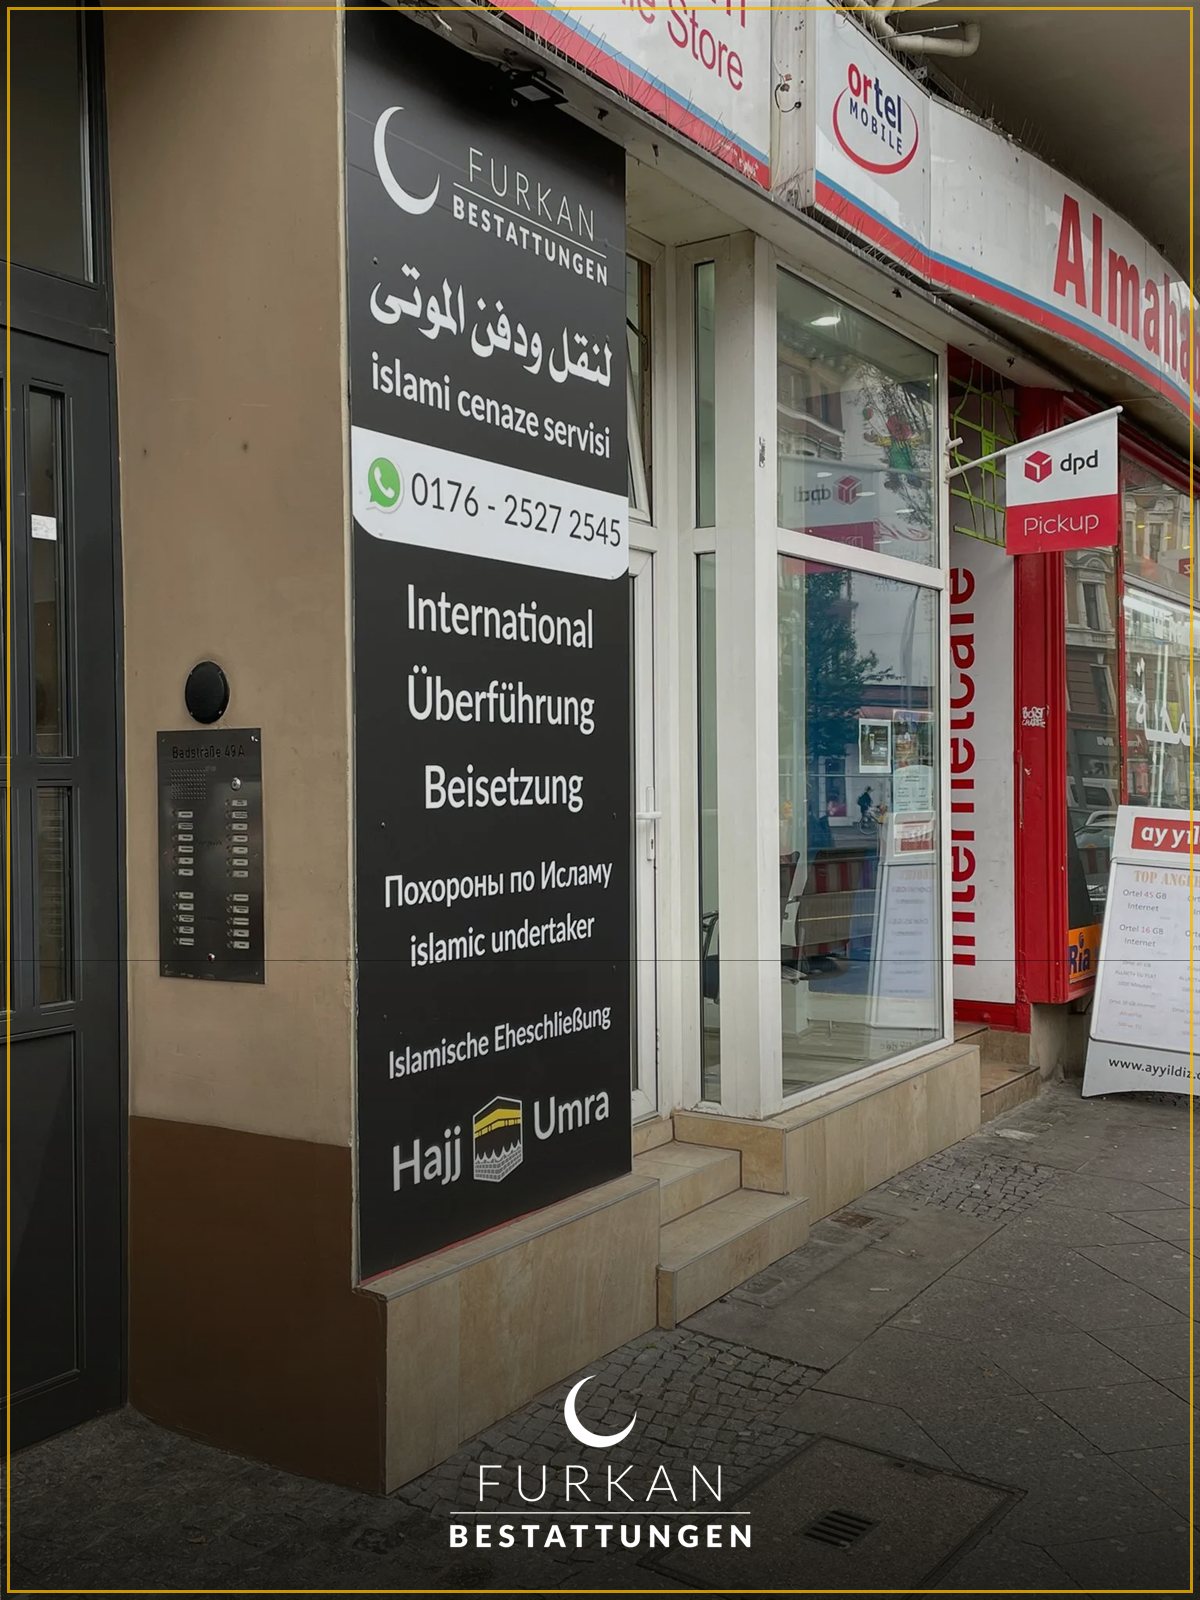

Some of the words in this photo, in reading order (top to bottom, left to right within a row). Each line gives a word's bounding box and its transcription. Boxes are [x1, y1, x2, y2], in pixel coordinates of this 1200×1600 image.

[667, 0, 743, 91] Store
[848, 63, 902, 134] ortel
[849, 97, 902, 156] MOBILE
[469, 146, 595, 242] FURKAN
[453, 194, 608, 286] BESTATTUNGEN
[370, 264, 465, 340] الموتى
[471, 297, 543, 375] ودفن
[549, 327, 613, 387] لنقل
[372, 351, 450, 411] islami
[458, 390, 539, 437] cenaze
[544, 416, 610, 458] servisi
[1060, 449, 1098, 475] dpd
[412, 472, 479, 517] 0176
[504, 494, 562, 535] 2527
[569, 510, 621, 547] 2545
[1024, 514, 1099, 536] Pickup
[407, 584, 593, 649] International
[408, 664, 595, 735] Überführung
[172, 745, 221, 759] Badstraße
[425, 764, 583, 813] Beisetzung
[385, 873, 504, 908] Похороны
[510, 870, 535, 895] по
[541, 860, 613, 890] Исламу
[1123, 889, 1142, 897] Ortel
[1134, 870, 1157, 884] TOP
[1120, 924, 1139, 932] Ortel
[1128, 903, 1159, 912] Internet
[410, 927, 485, 967] islamic
[491, 912, 595, 953] undertaker
[1124, 938, 1156, 947] Internet
[389, 1030, 489, 1079] Islamische
[494, 1006, 611, 1052] Eheschließung
[392, 1124, 461, 1192] Hajj
[533, 1090, 610, 1140] Umra
